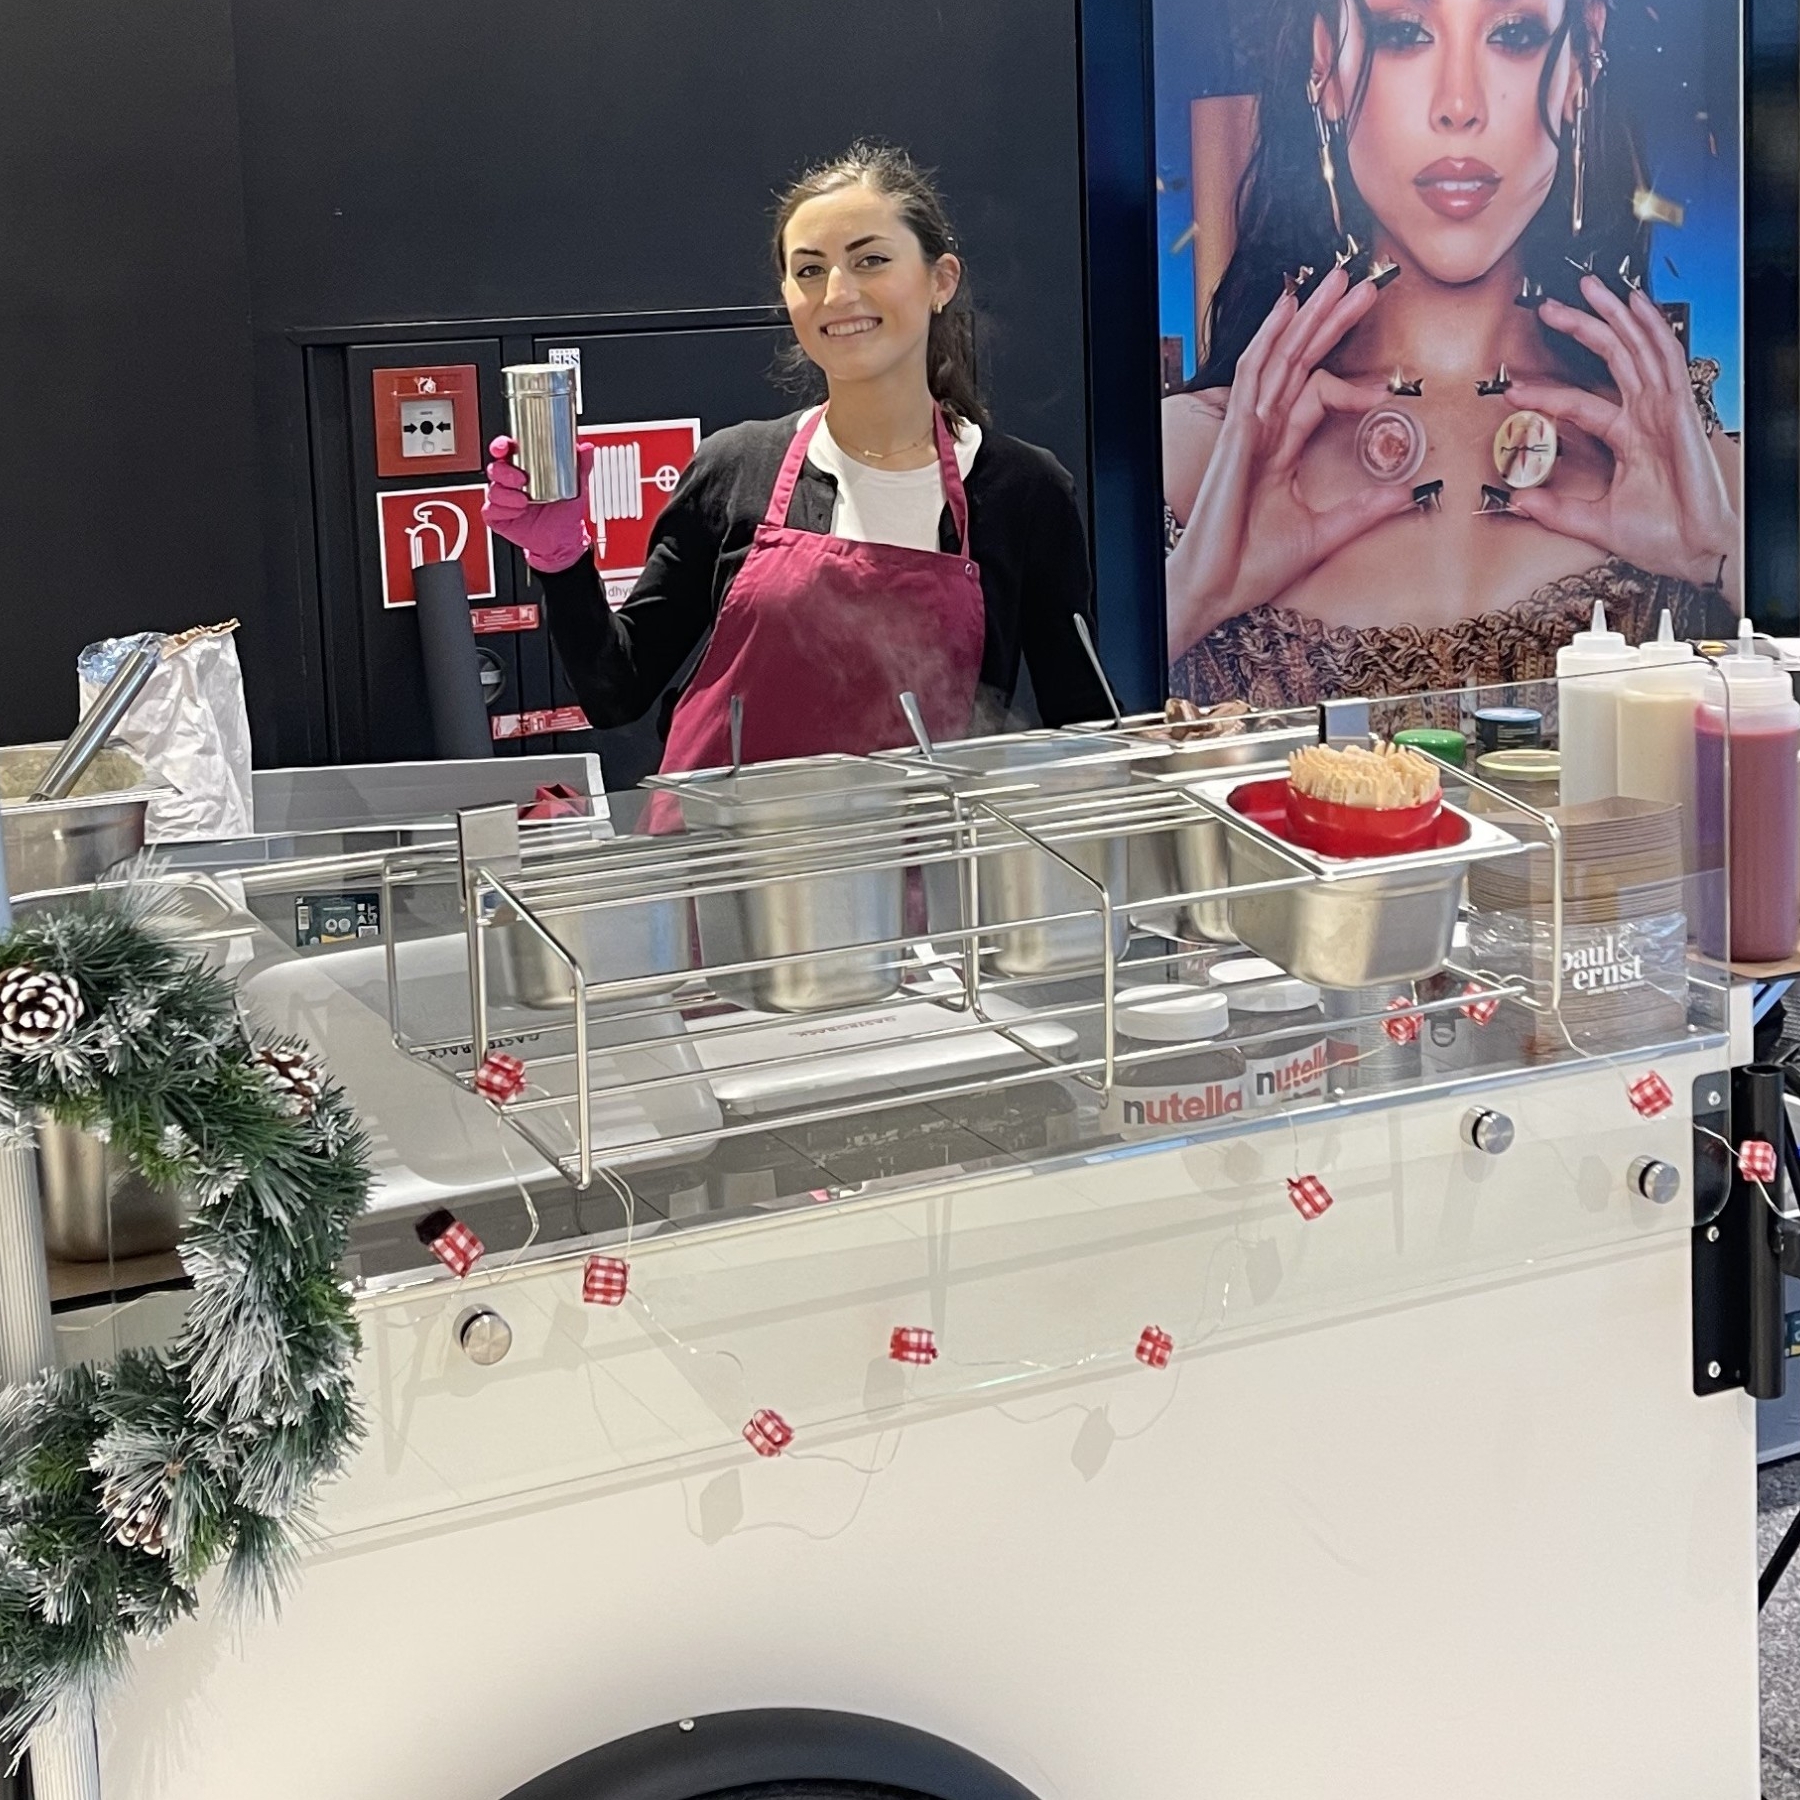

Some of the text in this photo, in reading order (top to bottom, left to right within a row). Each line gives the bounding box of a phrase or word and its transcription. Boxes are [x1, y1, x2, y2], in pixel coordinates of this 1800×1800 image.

[1572, 955, 1645, 990] ernst
[428, 1033, 540, 1060] GASTRRACK
[1257, 1045, 1327, 1096] nutell
[1123, 1084, 1243, 1125] nutella
